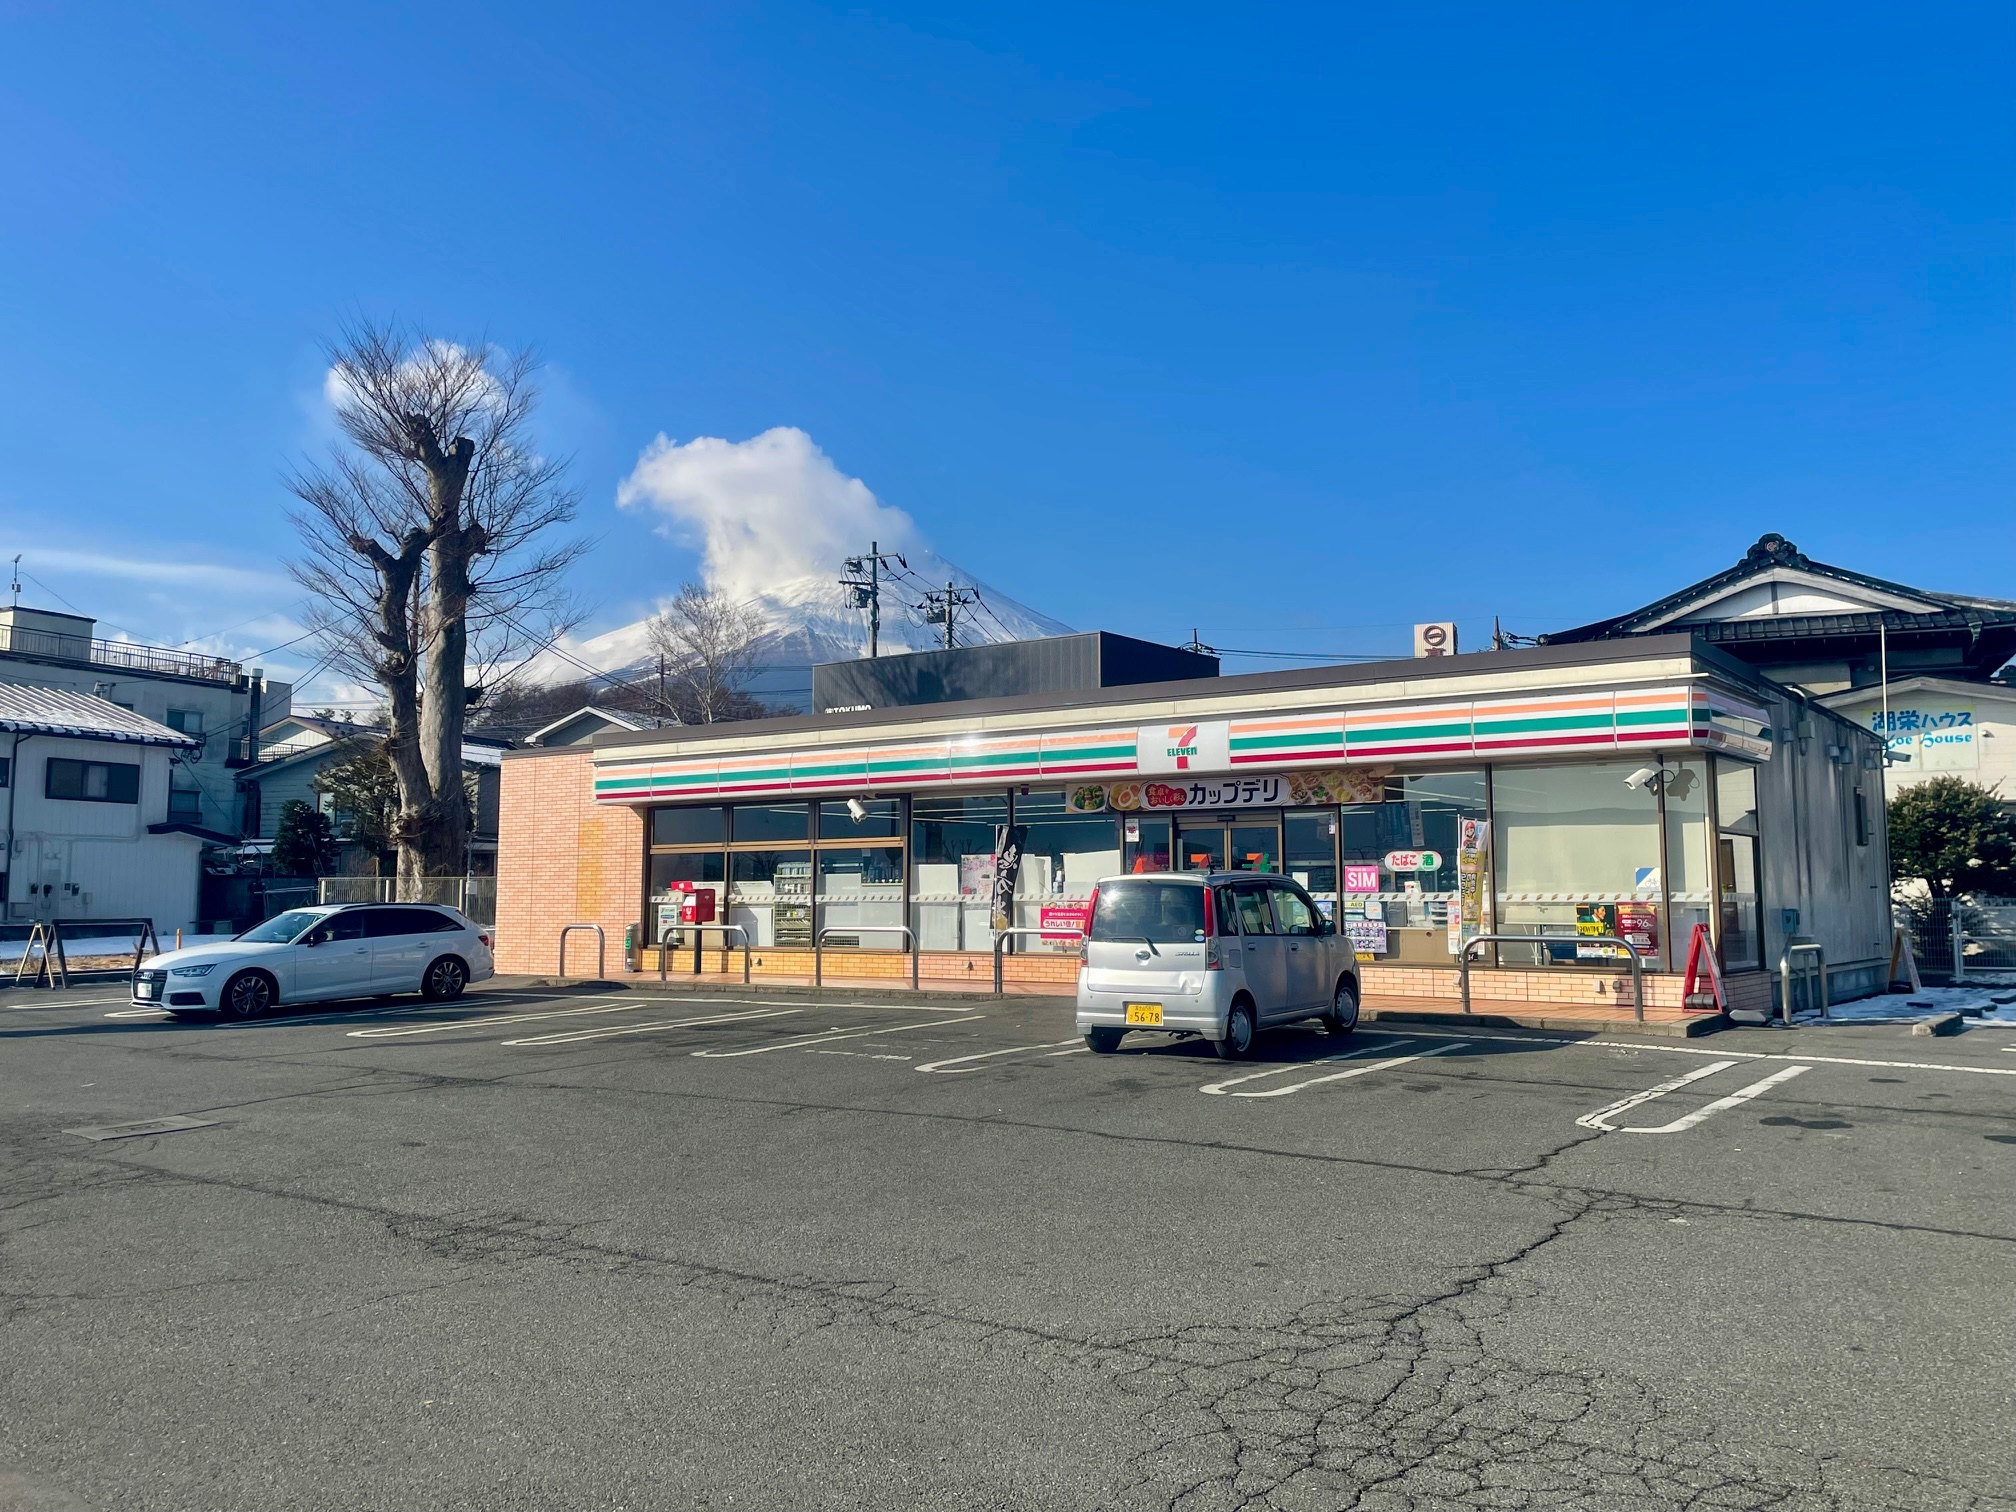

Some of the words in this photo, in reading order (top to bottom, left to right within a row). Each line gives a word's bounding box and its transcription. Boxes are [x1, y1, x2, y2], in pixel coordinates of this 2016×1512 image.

[1872, 710, 1974, 731] 湖栄ハウス
[1189, 779, 1279, 805] カップデリ
[1391, 854, 1417, 866] たばこ
[1422, 854, 1434, 866] 酒
[1347, 872, 1376, 888] SIM
[1134, 1012, 1160, 1022] 56-78
